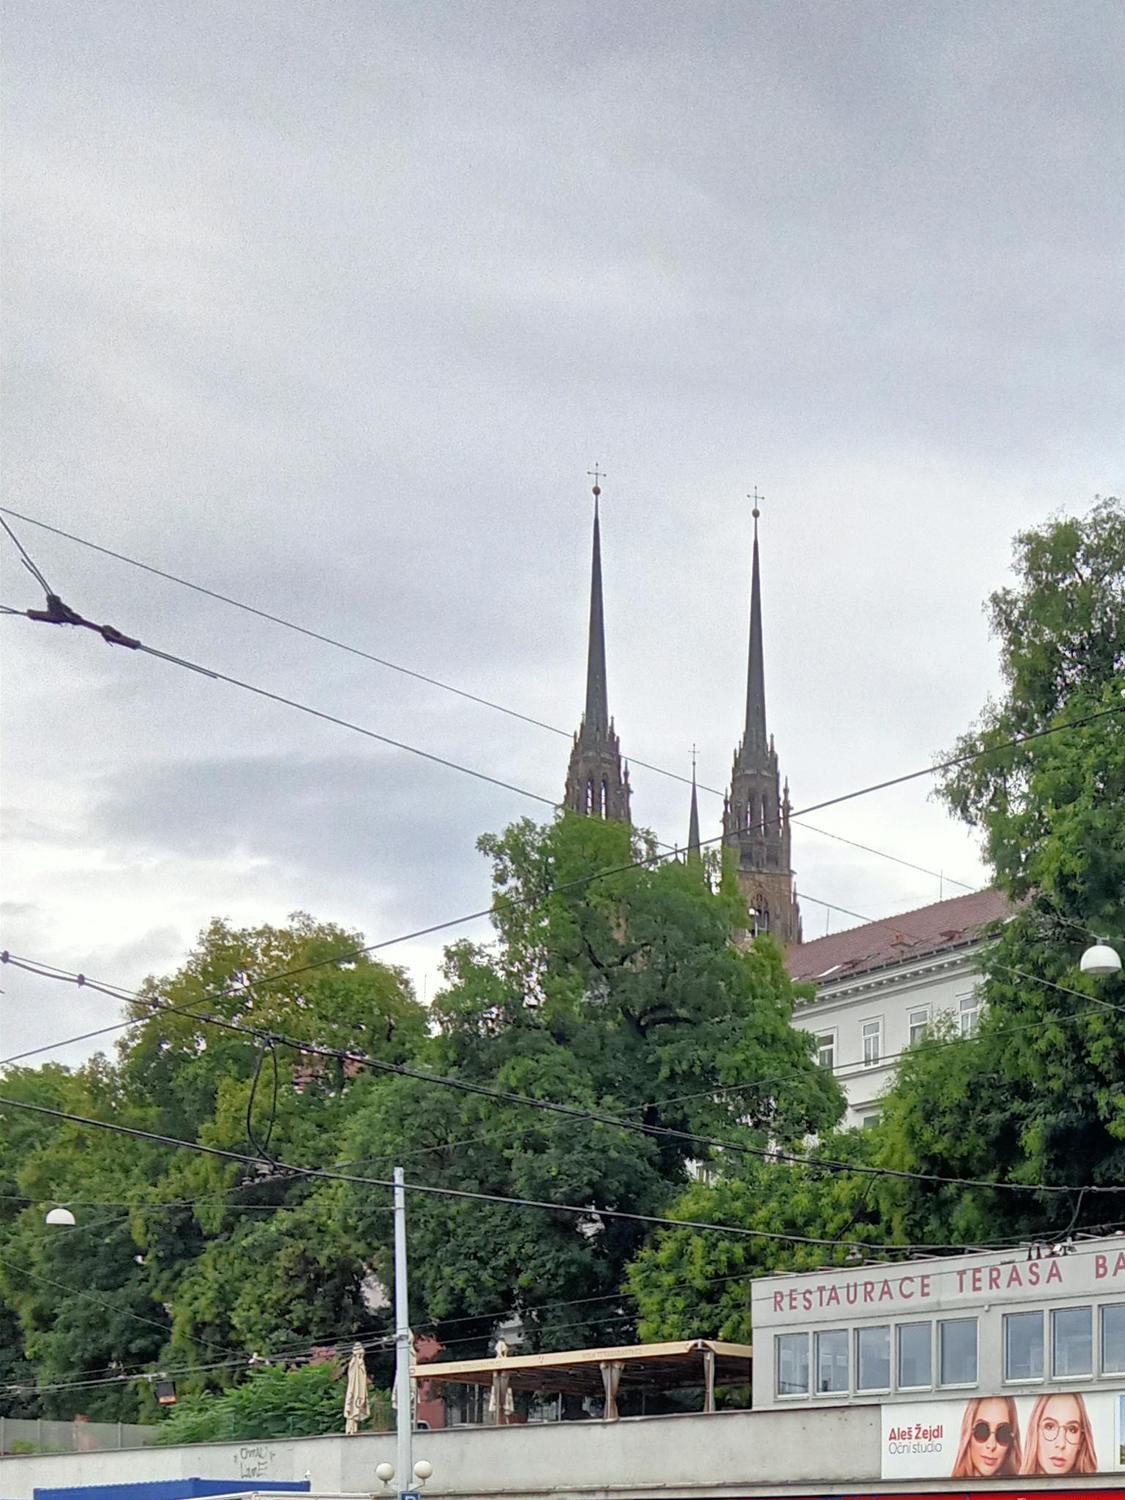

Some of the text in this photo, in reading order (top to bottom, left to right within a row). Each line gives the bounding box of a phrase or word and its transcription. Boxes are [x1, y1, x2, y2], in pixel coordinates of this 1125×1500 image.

[773, 1274, 931, 1312] RESTAURACE
[957, 1259, 1063, 1293] TERASA
[888, 1423, 944, 1441] Aleš Žejdl
[888, 1441, 943, 1454] Oční studio
